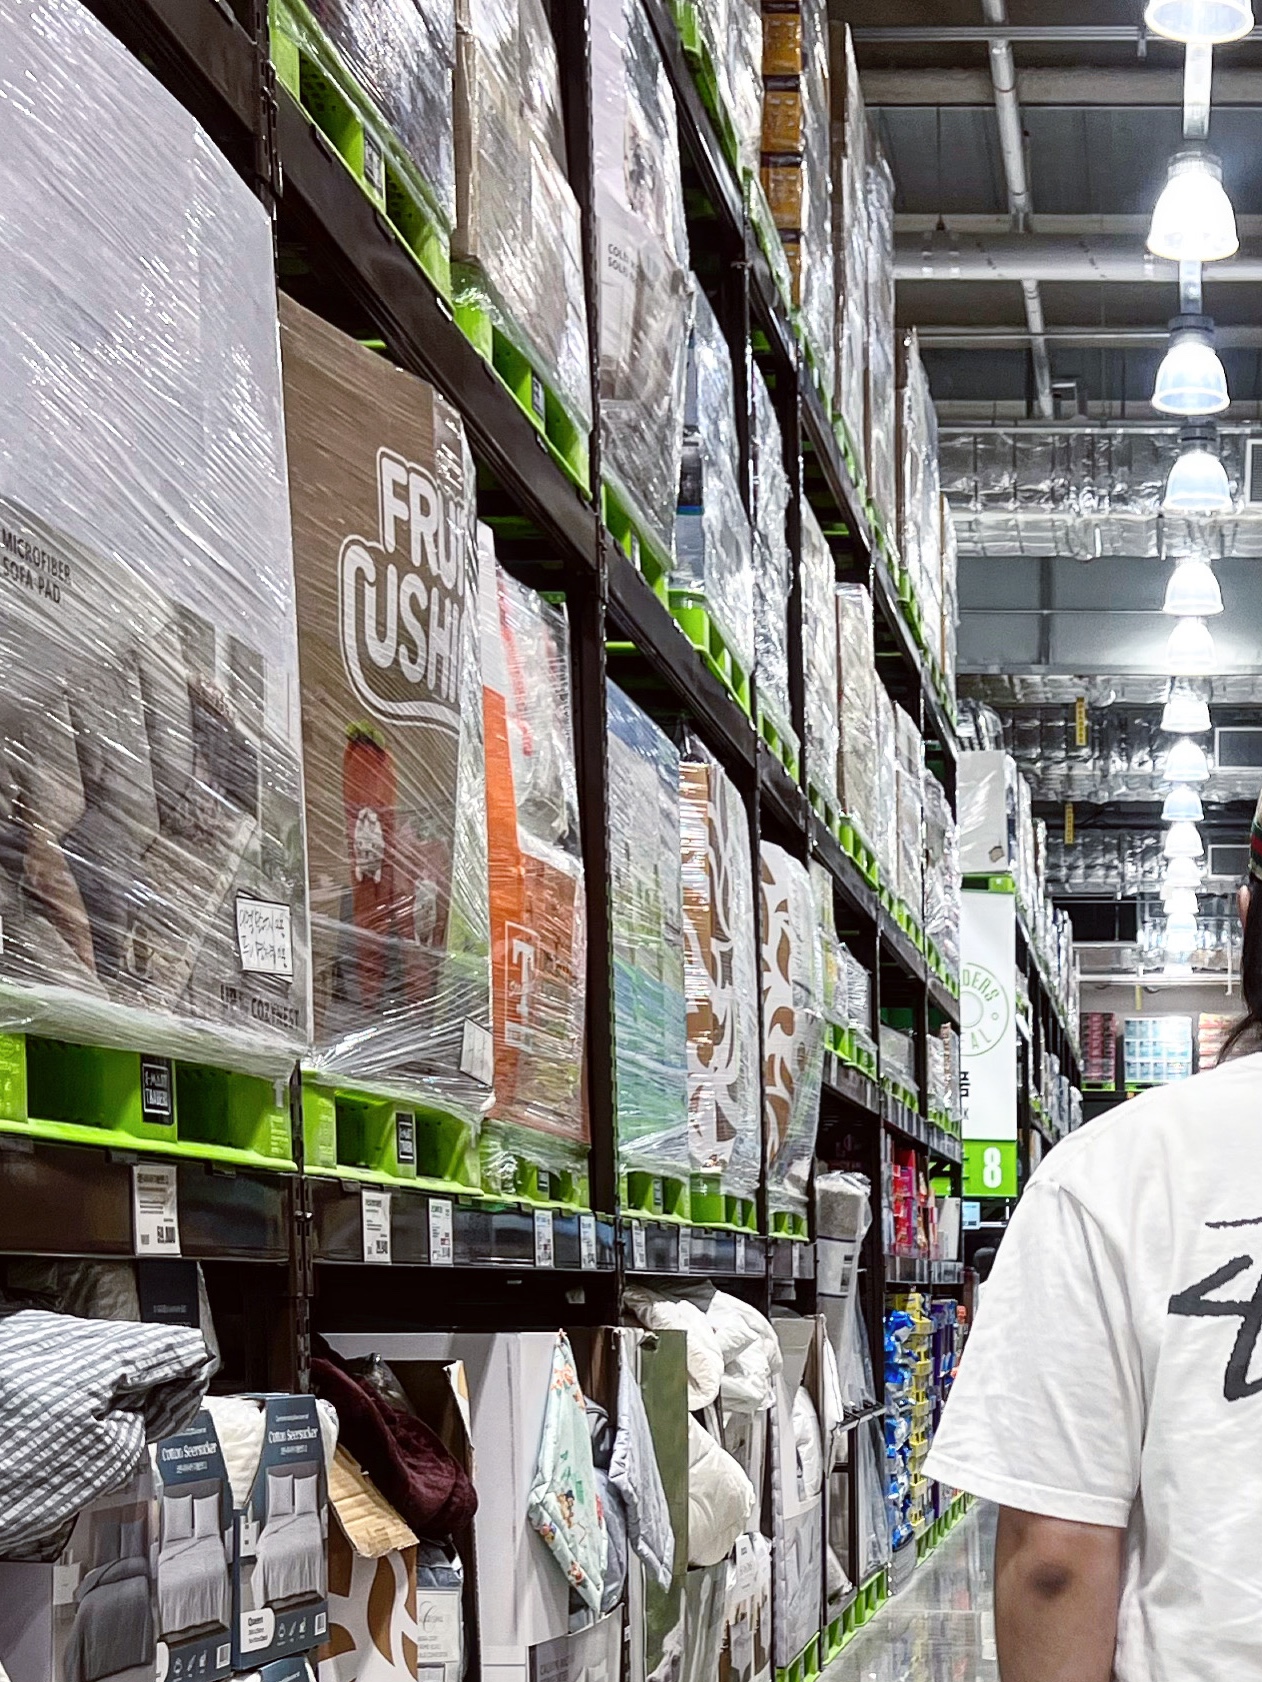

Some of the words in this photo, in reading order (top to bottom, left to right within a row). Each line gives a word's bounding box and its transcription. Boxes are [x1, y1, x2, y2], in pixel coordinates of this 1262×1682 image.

[2, 528, 71, 587] MICROFIBER
[3, 556, 34, 591] SOFA
[38, 575, 61, 605] PAD
[962, 968, 1000, 1003] DERS
[982, 1146, 1002, 1189] 8
[162, 1446, 184, 1462] Cotton
[184, 1440, 218, 1458] Seersucker
[268, 1430, 286, 1444] Cotton
[286, 1425, 318, 1443] Seersucker
